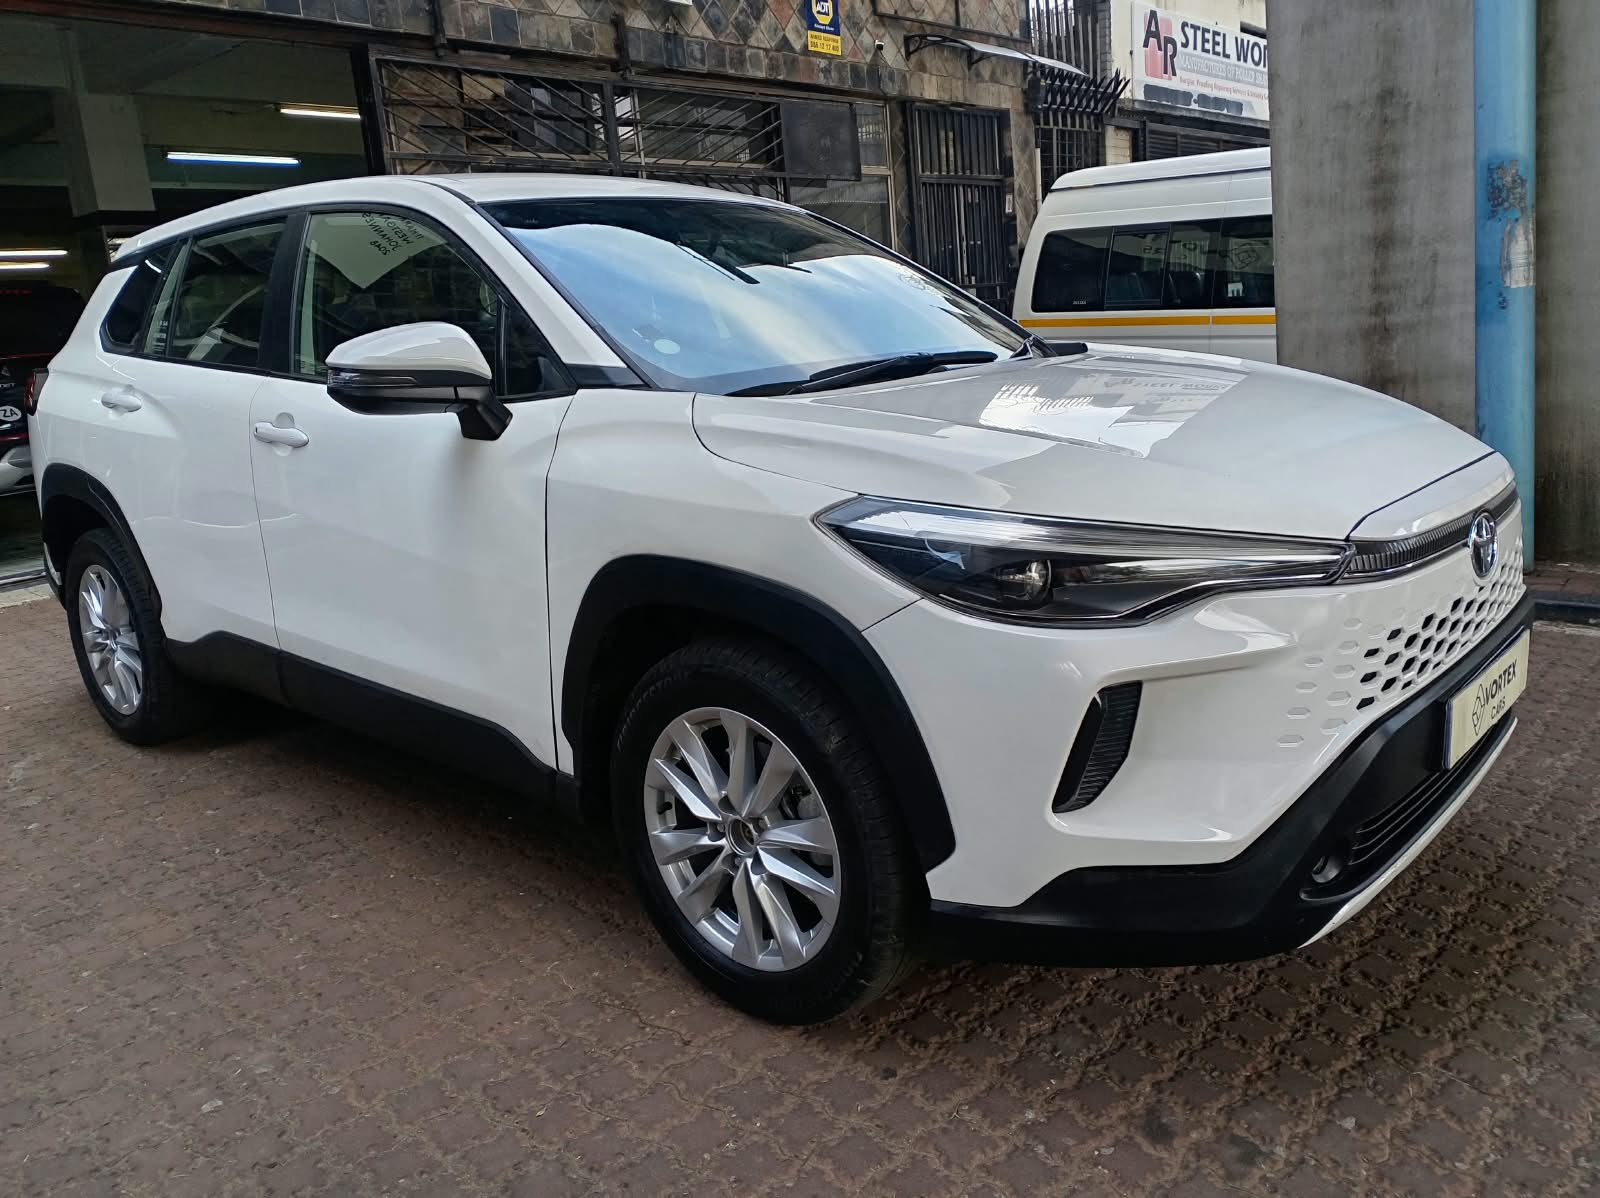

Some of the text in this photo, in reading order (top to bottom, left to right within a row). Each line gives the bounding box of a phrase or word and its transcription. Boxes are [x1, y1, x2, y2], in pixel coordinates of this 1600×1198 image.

[816, 1, 829, 13] ADT
[1180, 21, 1231, 60] STEEL
[0, 408, 19, 418] ZA
[1485, 660, 1517, 705] VORTEX
